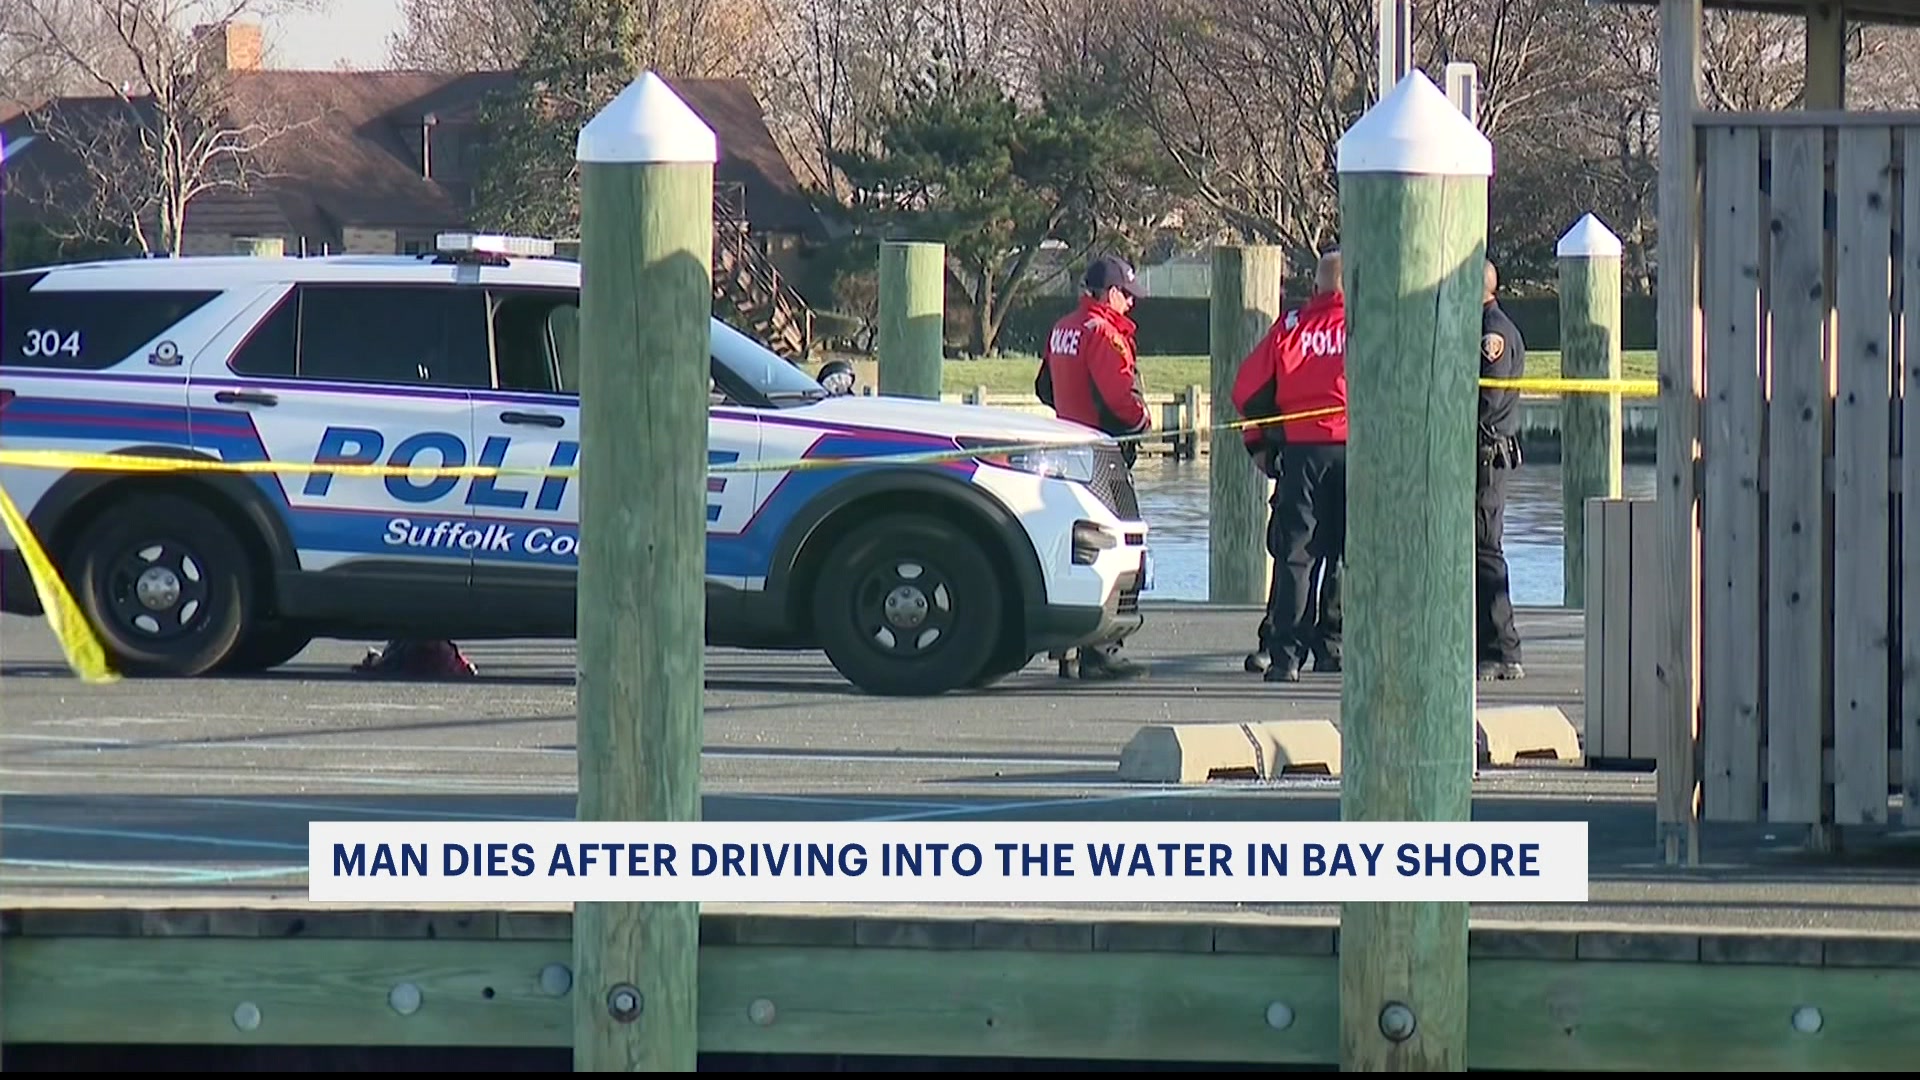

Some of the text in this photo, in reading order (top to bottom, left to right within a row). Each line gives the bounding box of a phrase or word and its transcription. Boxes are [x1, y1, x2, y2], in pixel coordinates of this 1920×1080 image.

[22, 328, 81, 358] 304
[1050, 327, 1081, 355] OLICE
[1300, 328, 1346, 357] POLI
[302, 426, 740, 522] POLI
[383, 518, 580, 555] Suffolk Co
